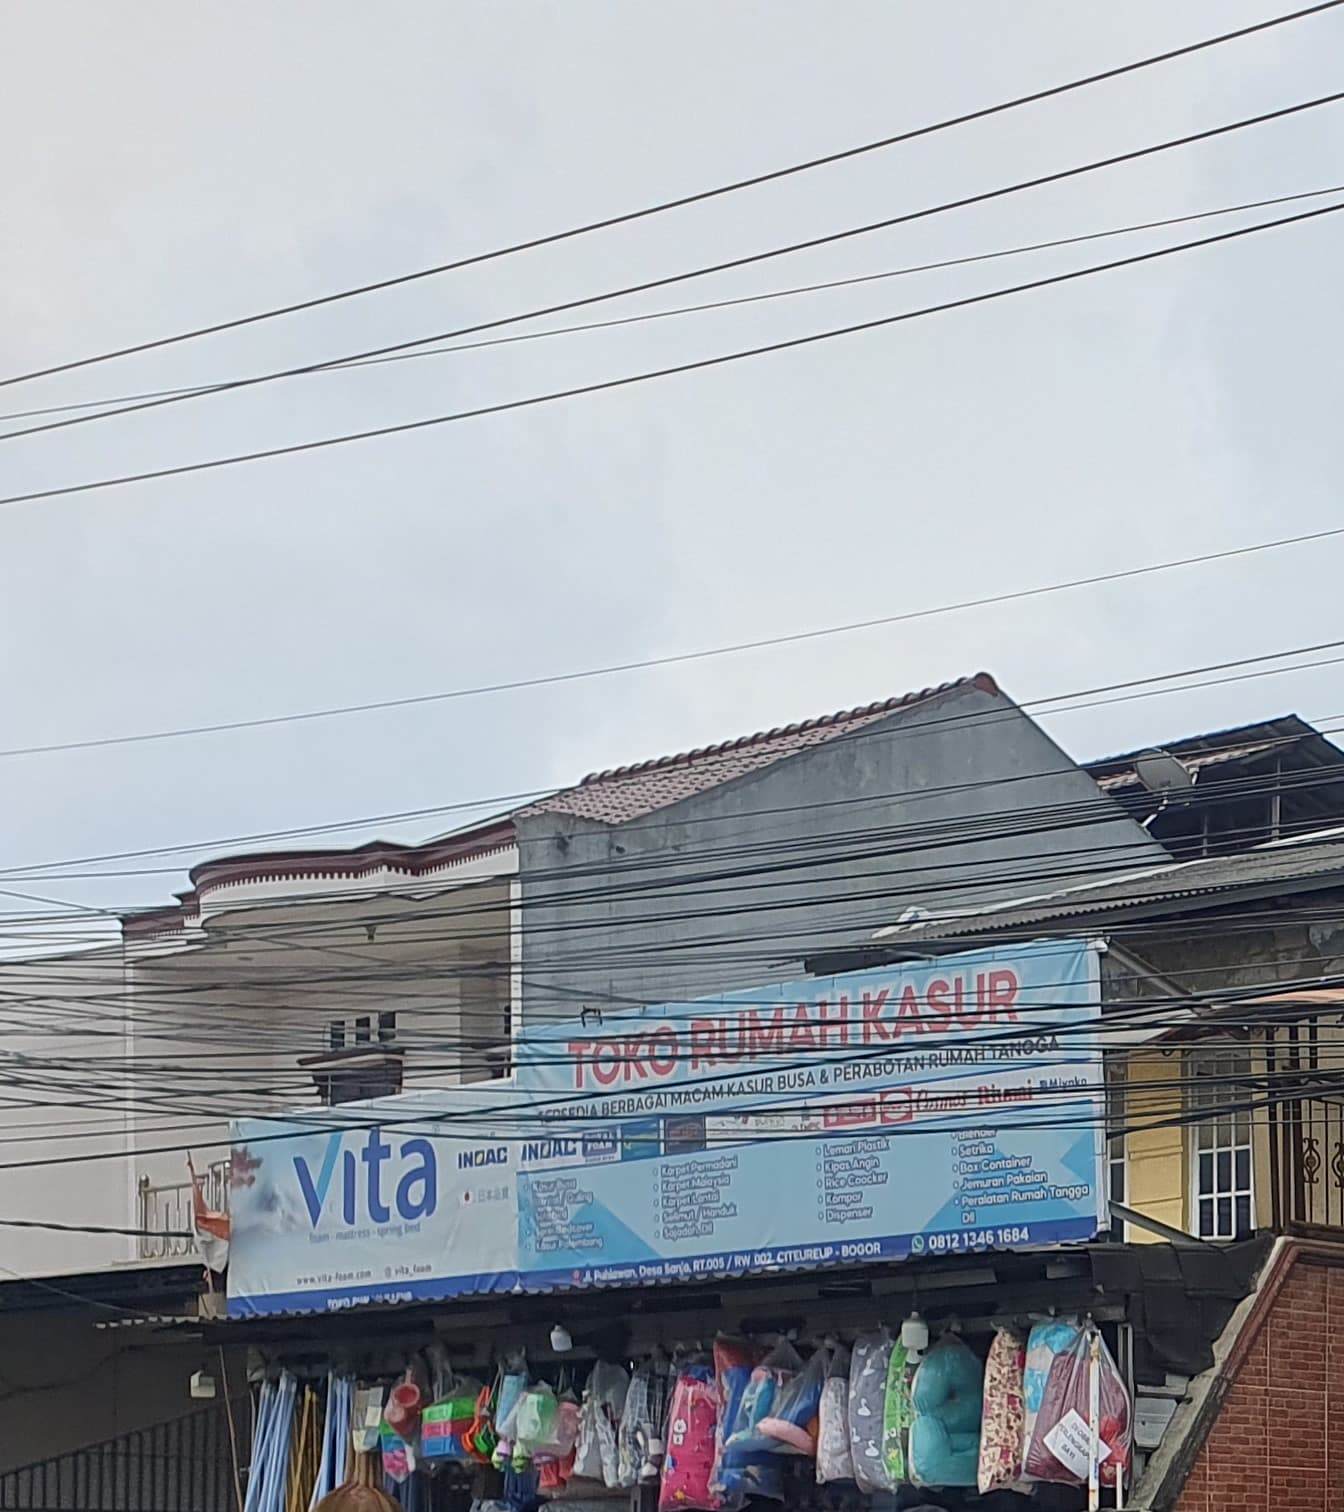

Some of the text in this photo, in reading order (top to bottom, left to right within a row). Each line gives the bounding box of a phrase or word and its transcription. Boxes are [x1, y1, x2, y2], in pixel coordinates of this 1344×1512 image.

[567, 968, 1019, 1089] TOKO RUMAH KASUR
[601, 1093, 667, 1115] BERBAGAI
[671, 1085, 723, 1106] MACAM
[727, 1076, 774, 1098] KASUR
[777, 1070, 816, 1090] BUSA
[819, 1067, 830, 1084] &
[834, 1055, 925, 1082] PERABOTAN
[929, 1047, 985, 1069] RUMAH
[457, 1146, 508, 1170] INOAC
[959, 1143, 994, 1157] Setrika
[824, 1156, 880, 1175] Kipas Angin
[981, 1156, 1032, 1171] Container
[661, 1180, 691, 1195] Karpet
[825, 1175, 848, 1188] Rice
[960, 1172, 1048, 1191] Jemuran Pakaian
[662, 1195, 691, 1209] Karpet
[961, 1184, 1090, 1208] Peralatan Rumah Tangga
[826, 1206, 873, 1224] Dispenser
[928, 1226, 1029, 1250] 0812 1346 1684
[734, 1254, 751, 1269] RW
[777, 1247, 833, 1263] CITEUREUP
[841, 1242, 881, 1257] BOGOR
